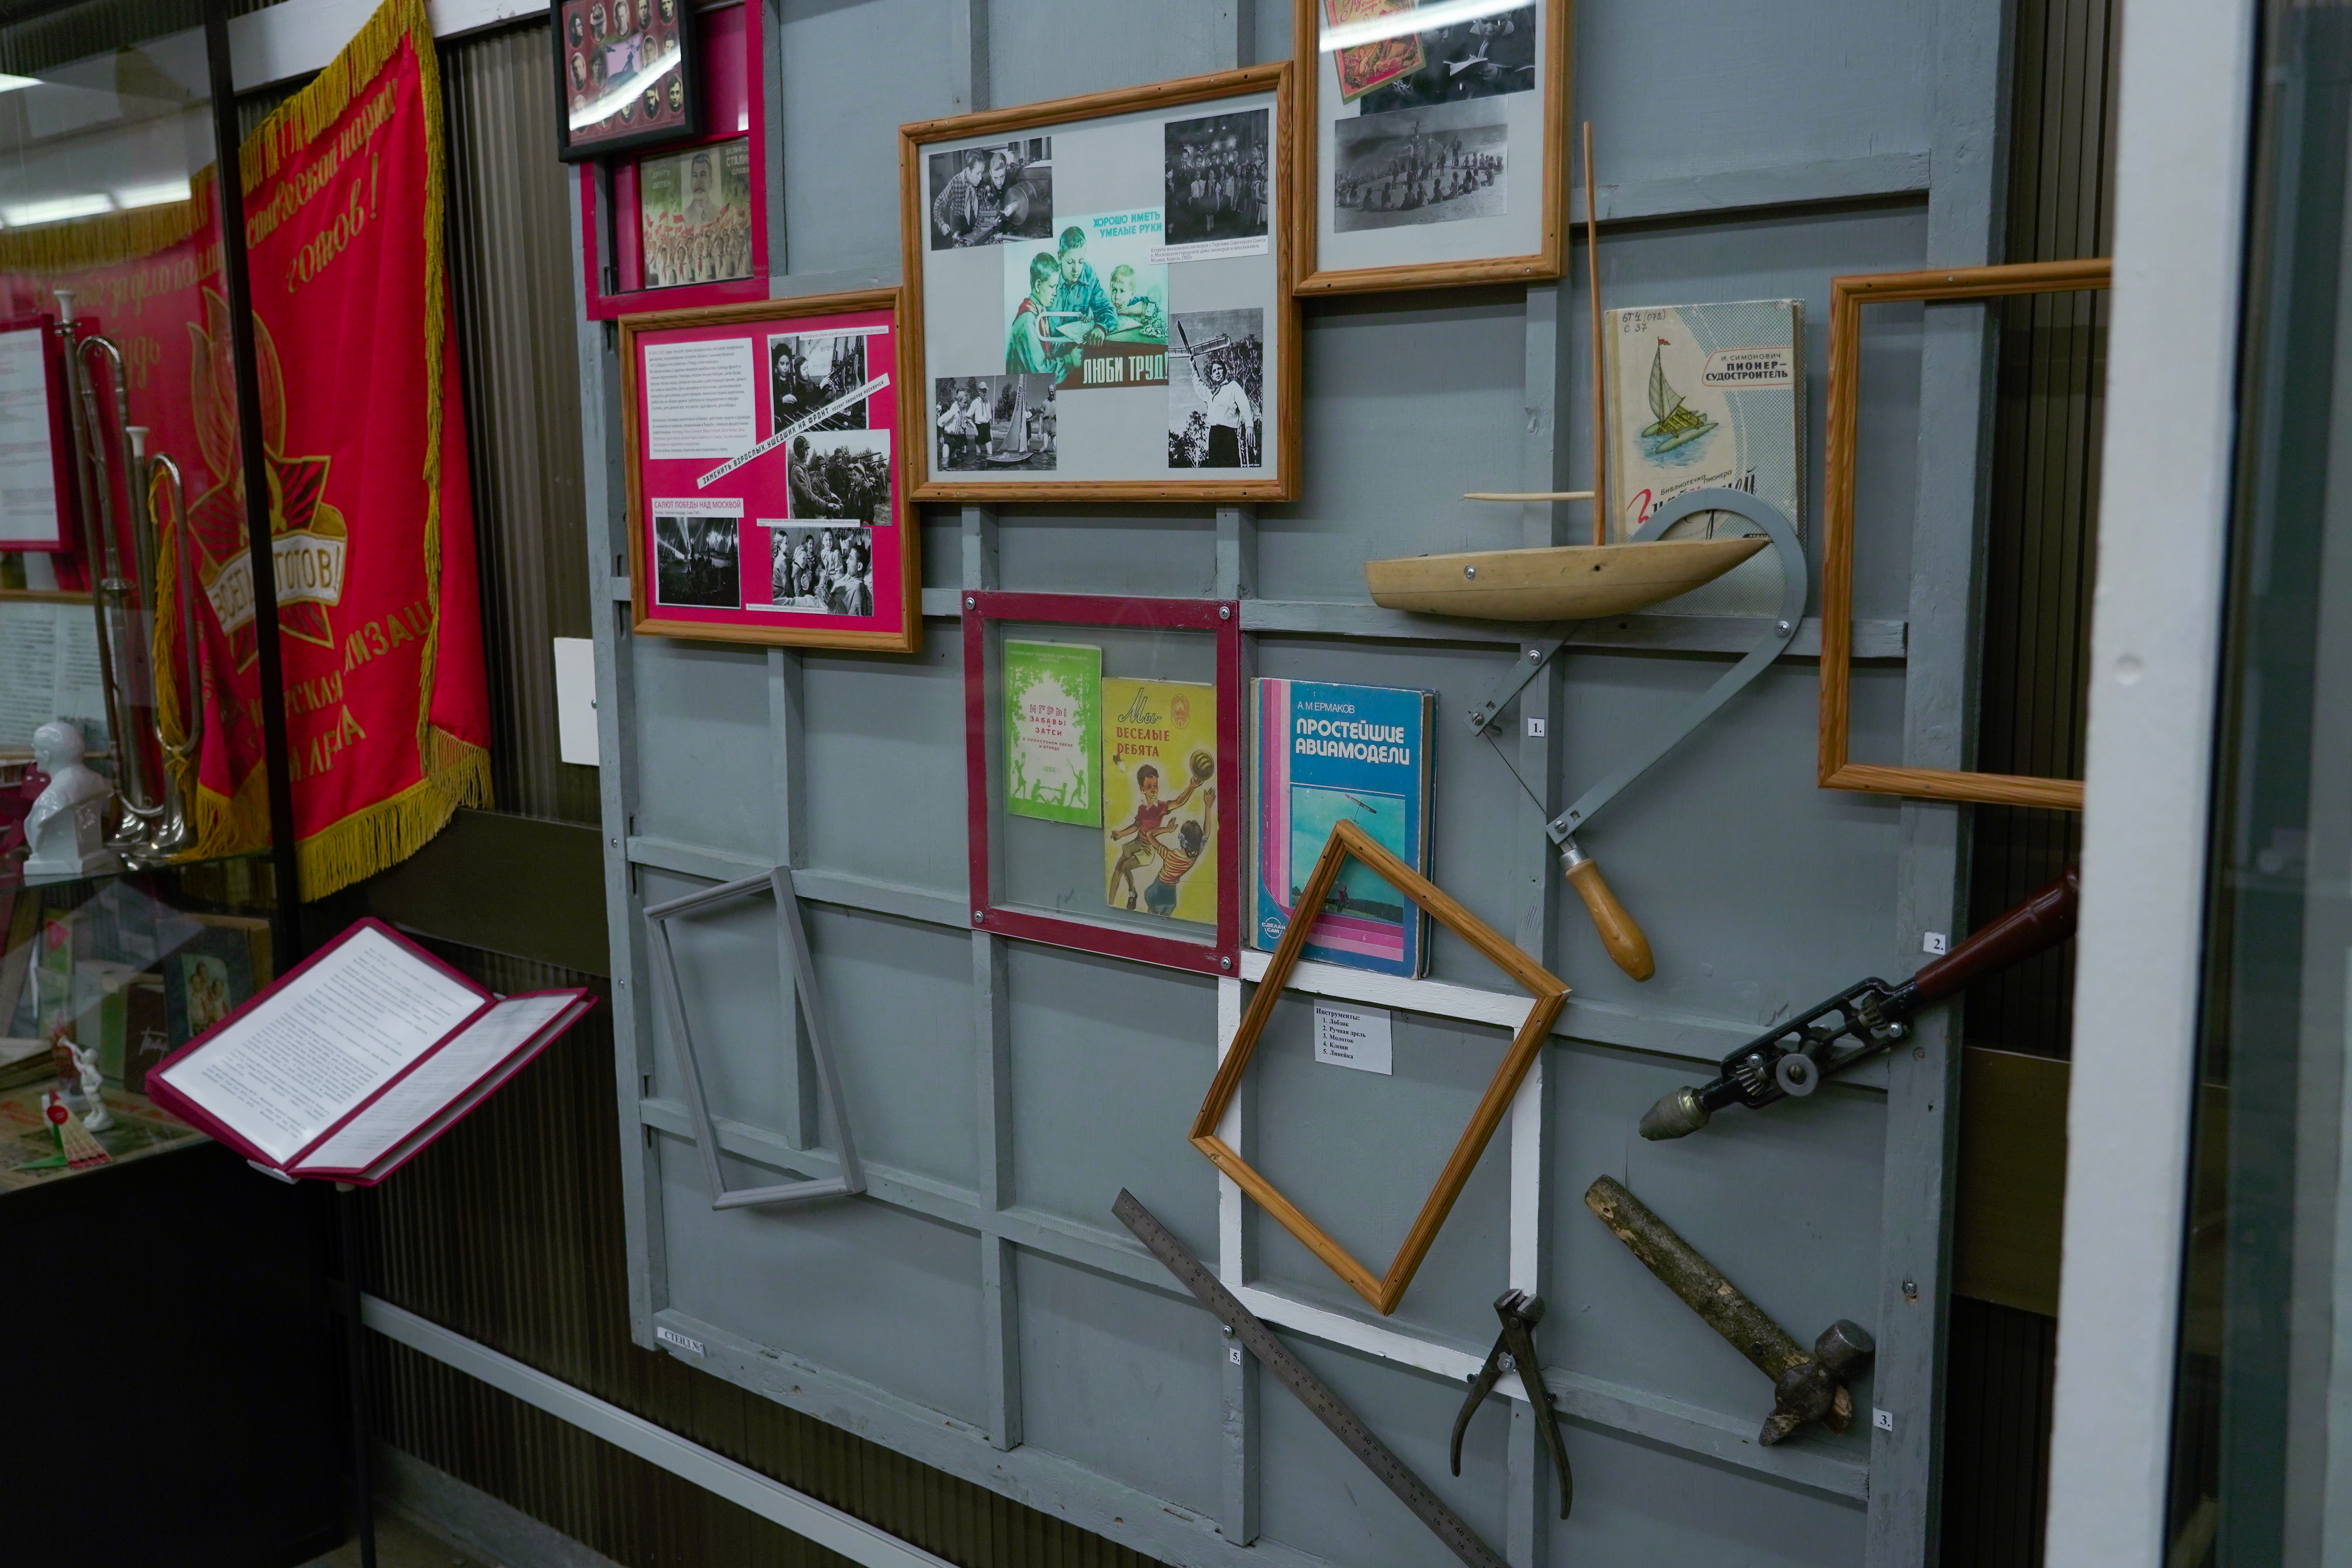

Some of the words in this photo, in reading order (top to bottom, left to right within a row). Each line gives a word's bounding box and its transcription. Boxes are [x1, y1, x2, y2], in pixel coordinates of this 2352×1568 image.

[1093, 215, 1128, 228] ХОРОШО
[1131, 211, 1160, 223] ИМЕТЬ
[1100, 225, 1136, 238] УМЕЛЫЕ
[1139, 223, 1162, 233] РУКИ
[1730, 353, 1782, 361] СИМОНОВИЧ
[1083, 357, 1123, 384] ЛЮБИ
[1128, 351, 1169, 381] ТРУД!
[1706, 371, 1788, 381] СУДОСТРОИТЕЛЬ
[703, 464, 732, 484] ЗАМЕНИТЬ
[767, 428, 796, 448] УШЕДШИХ
[798, 421, 806, 430] НА
[808, 408, 829, 424] ФРОНТ
[832, 402, 845, 412] ЛОЗУНГ
[845, 392, 863, 404] ПИОНЕРОВ
[1661, 474, 1706, 495] Библиотечка
[1704, 469, 1732, 484] пионера
[675, 501, 698, 509] ПОБЕДЫ
[701, 501, 711, 509] НАД
[713, 500, 741, 508] МОСКВОЙ
[1030, 704, 1066, 717] ИГРЫ
[1030, 716, 1066, 725] ЗАБАВЫ
[1035, 728, 1062, 736] ЗАТЕИ
[1117, 727, 1169, 741] ВЕСЕЛЫЕ
[1296, 718, 1404, 744] ПРОСТЕЙШИЕ
[1534, 723, 1542, 733] 1.
[1117, 743, 1159, 760] РЕБЯТА
[1296, 738, 1410, 765] АВИАМОДЕЛИ
[1933, 939, 1944, 951] 2.
[1316, 1008, 1360, 1021] Инструменты:
[1329, 1019, 1349, 1027] Лобзик
[1330, 1026, 1349, 1035] Ручная
[1330, 1035, 1354, 1043] Молоток
[1330, 1042, 1348, 1050] Клещи
[1330, 1050, 1353, 1059] Линейка
[1233, 1352, 1239, 1361] 5.
[1275, 1349, 1283, 1359] 20
[1362, 1435, 1371, 1445] 30
[1455, 1527, 1464, 1536] 40
[1386, 1471, 1393, 1479] 13
[1458, 1542, 1465, 1550] 16
